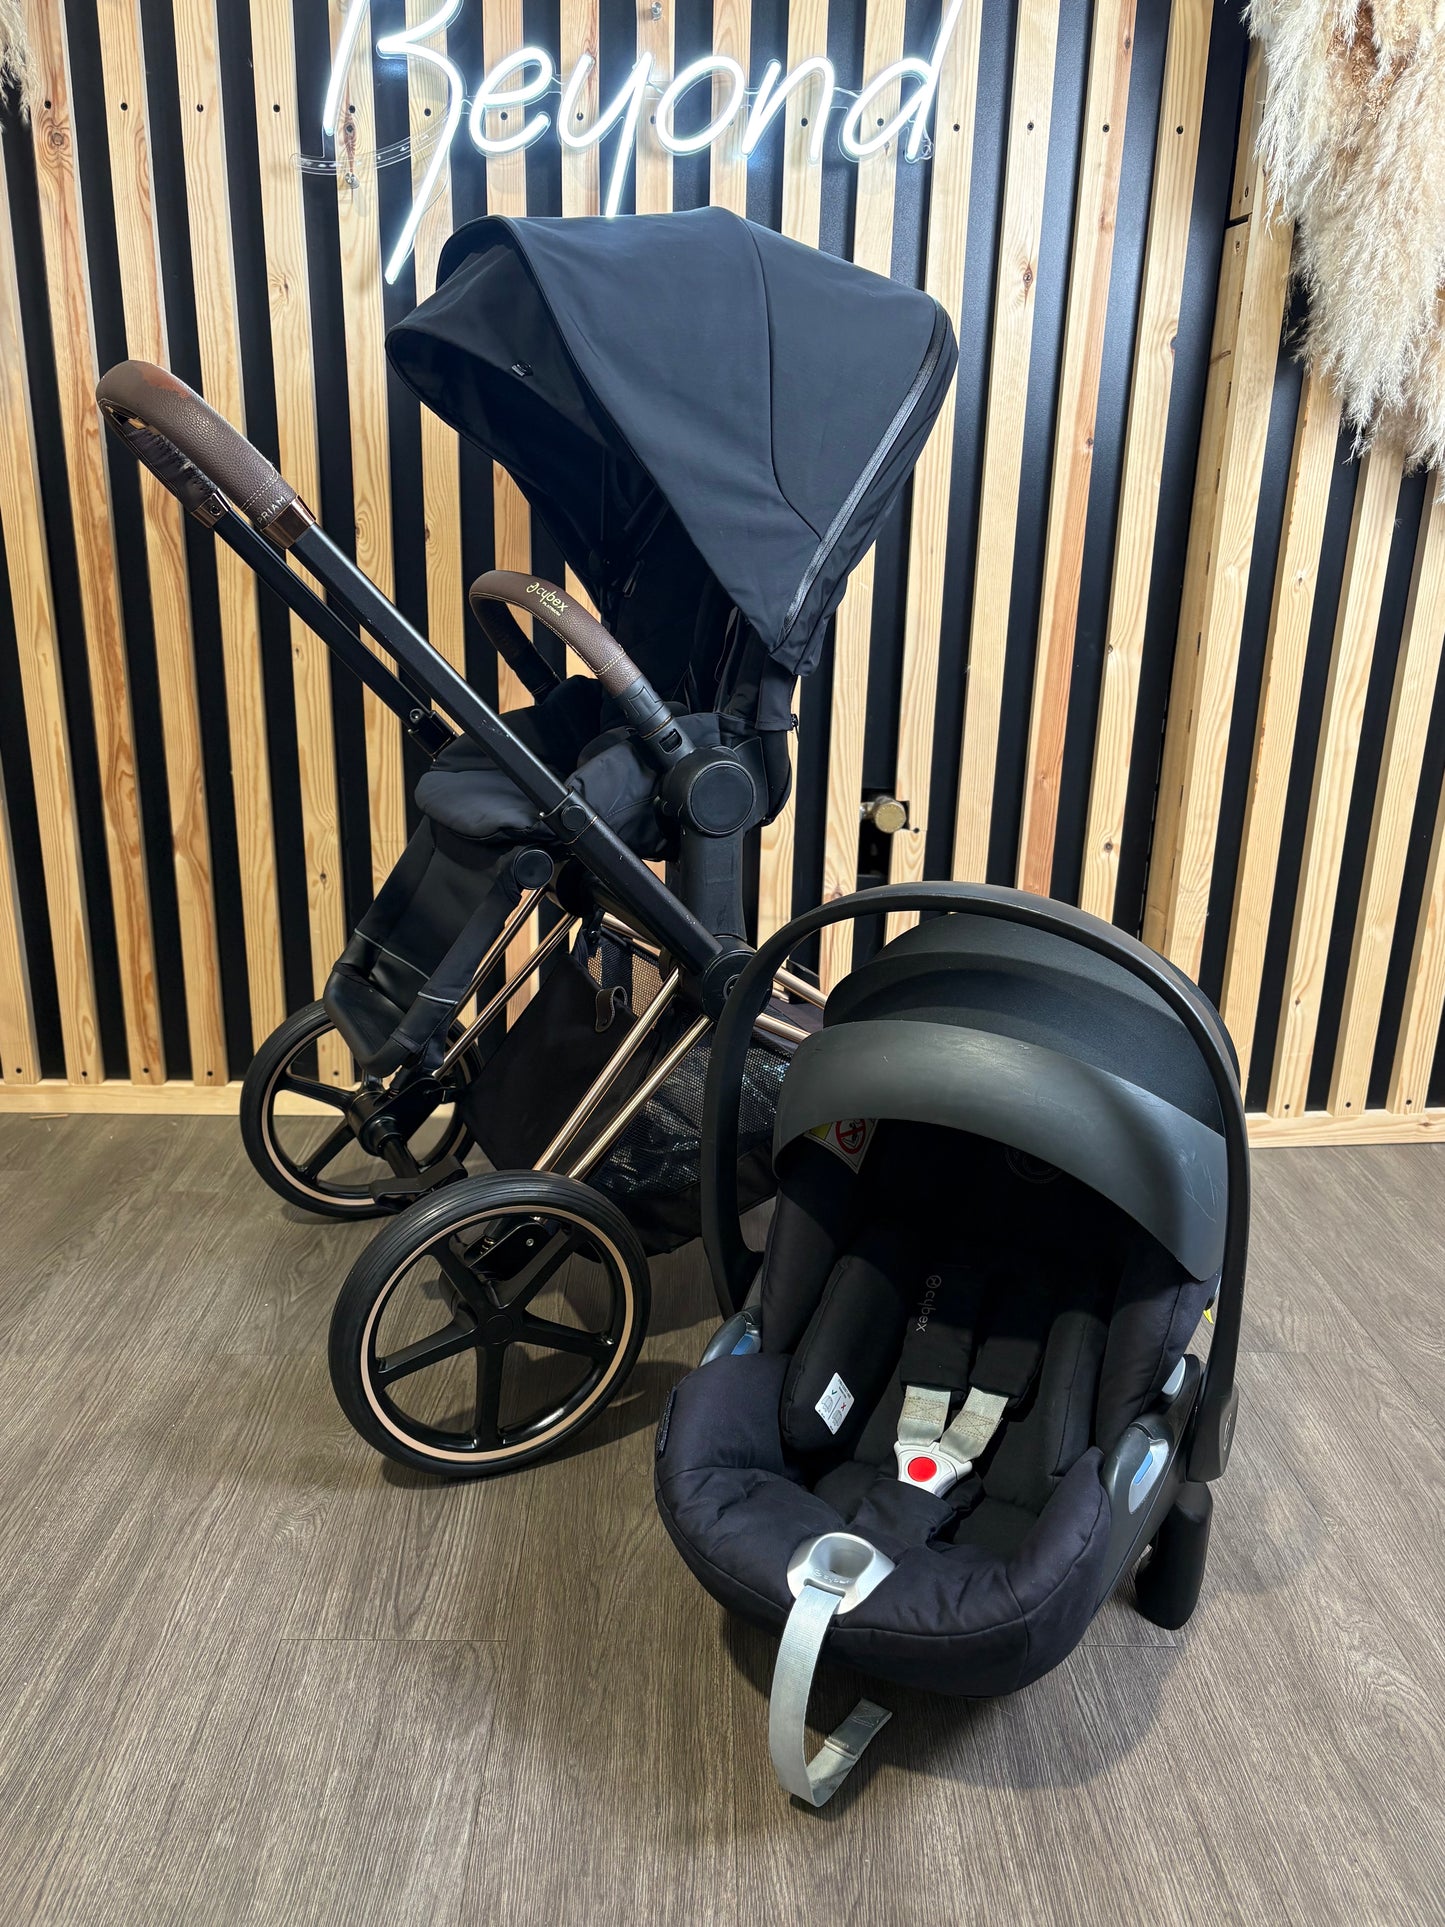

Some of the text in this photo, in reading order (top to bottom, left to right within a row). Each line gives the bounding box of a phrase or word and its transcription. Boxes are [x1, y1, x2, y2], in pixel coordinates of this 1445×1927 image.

[322, 0, 962, 285] Beyond
[256, 495, 287, 524] PRIAM
[535, 586, 569, 613] cybex
[915, 1290, 936, 1332] cybex
